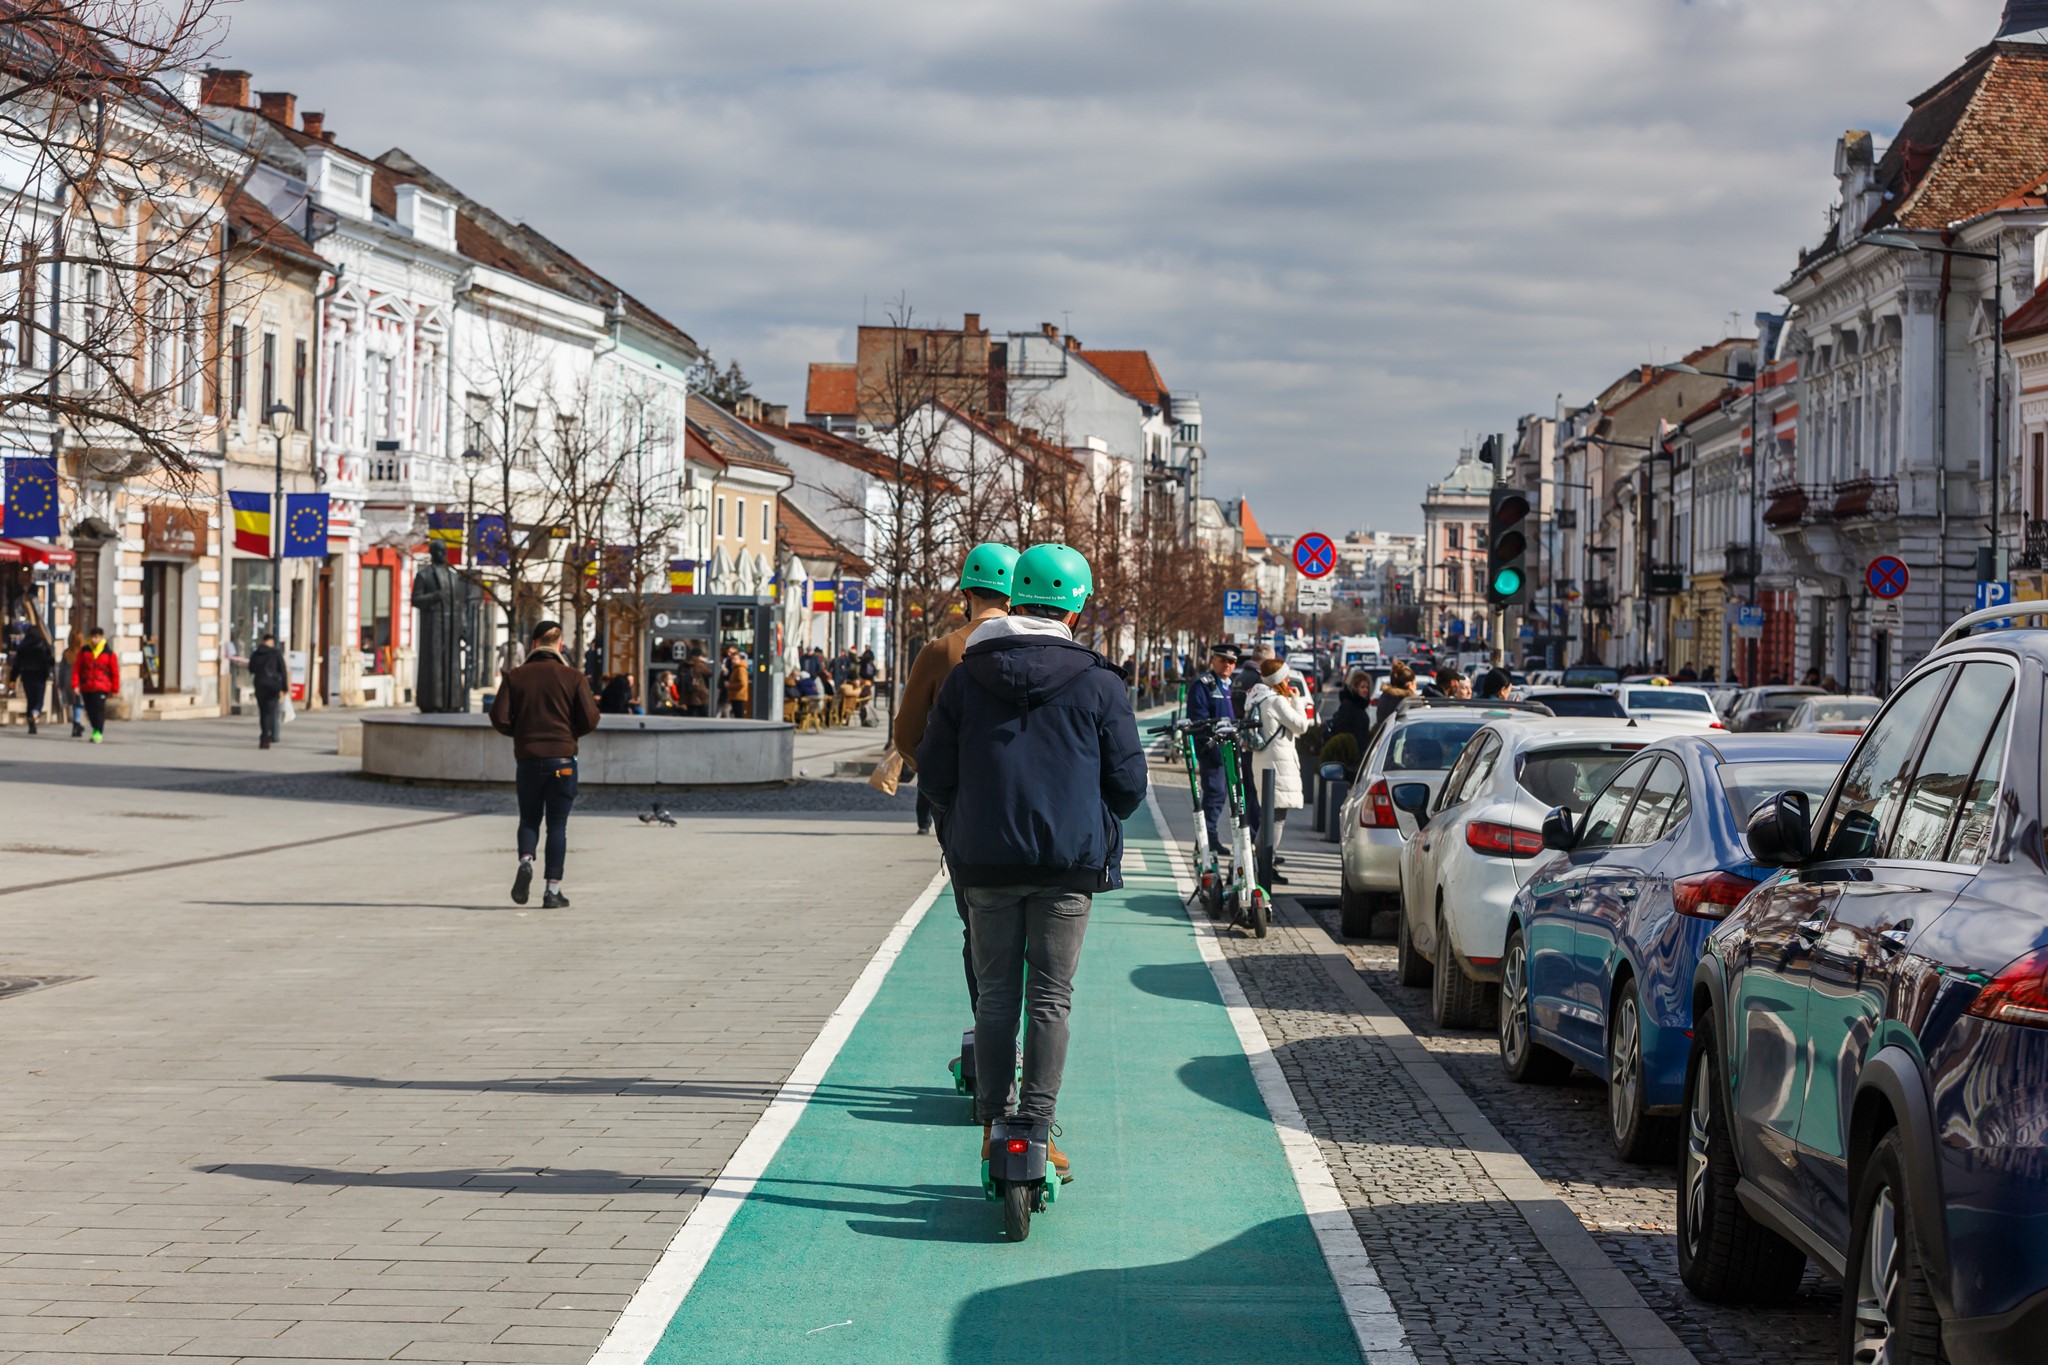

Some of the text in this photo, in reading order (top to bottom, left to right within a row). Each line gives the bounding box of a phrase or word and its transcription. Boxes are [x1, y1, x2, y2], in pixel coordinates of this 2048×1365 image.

[1072, 584, 1086, 598] Bolt
[1985, 583, 2005, 609] P
[1227, 592, 1240, 610] P
[1740, 607, 1750, 620] P
